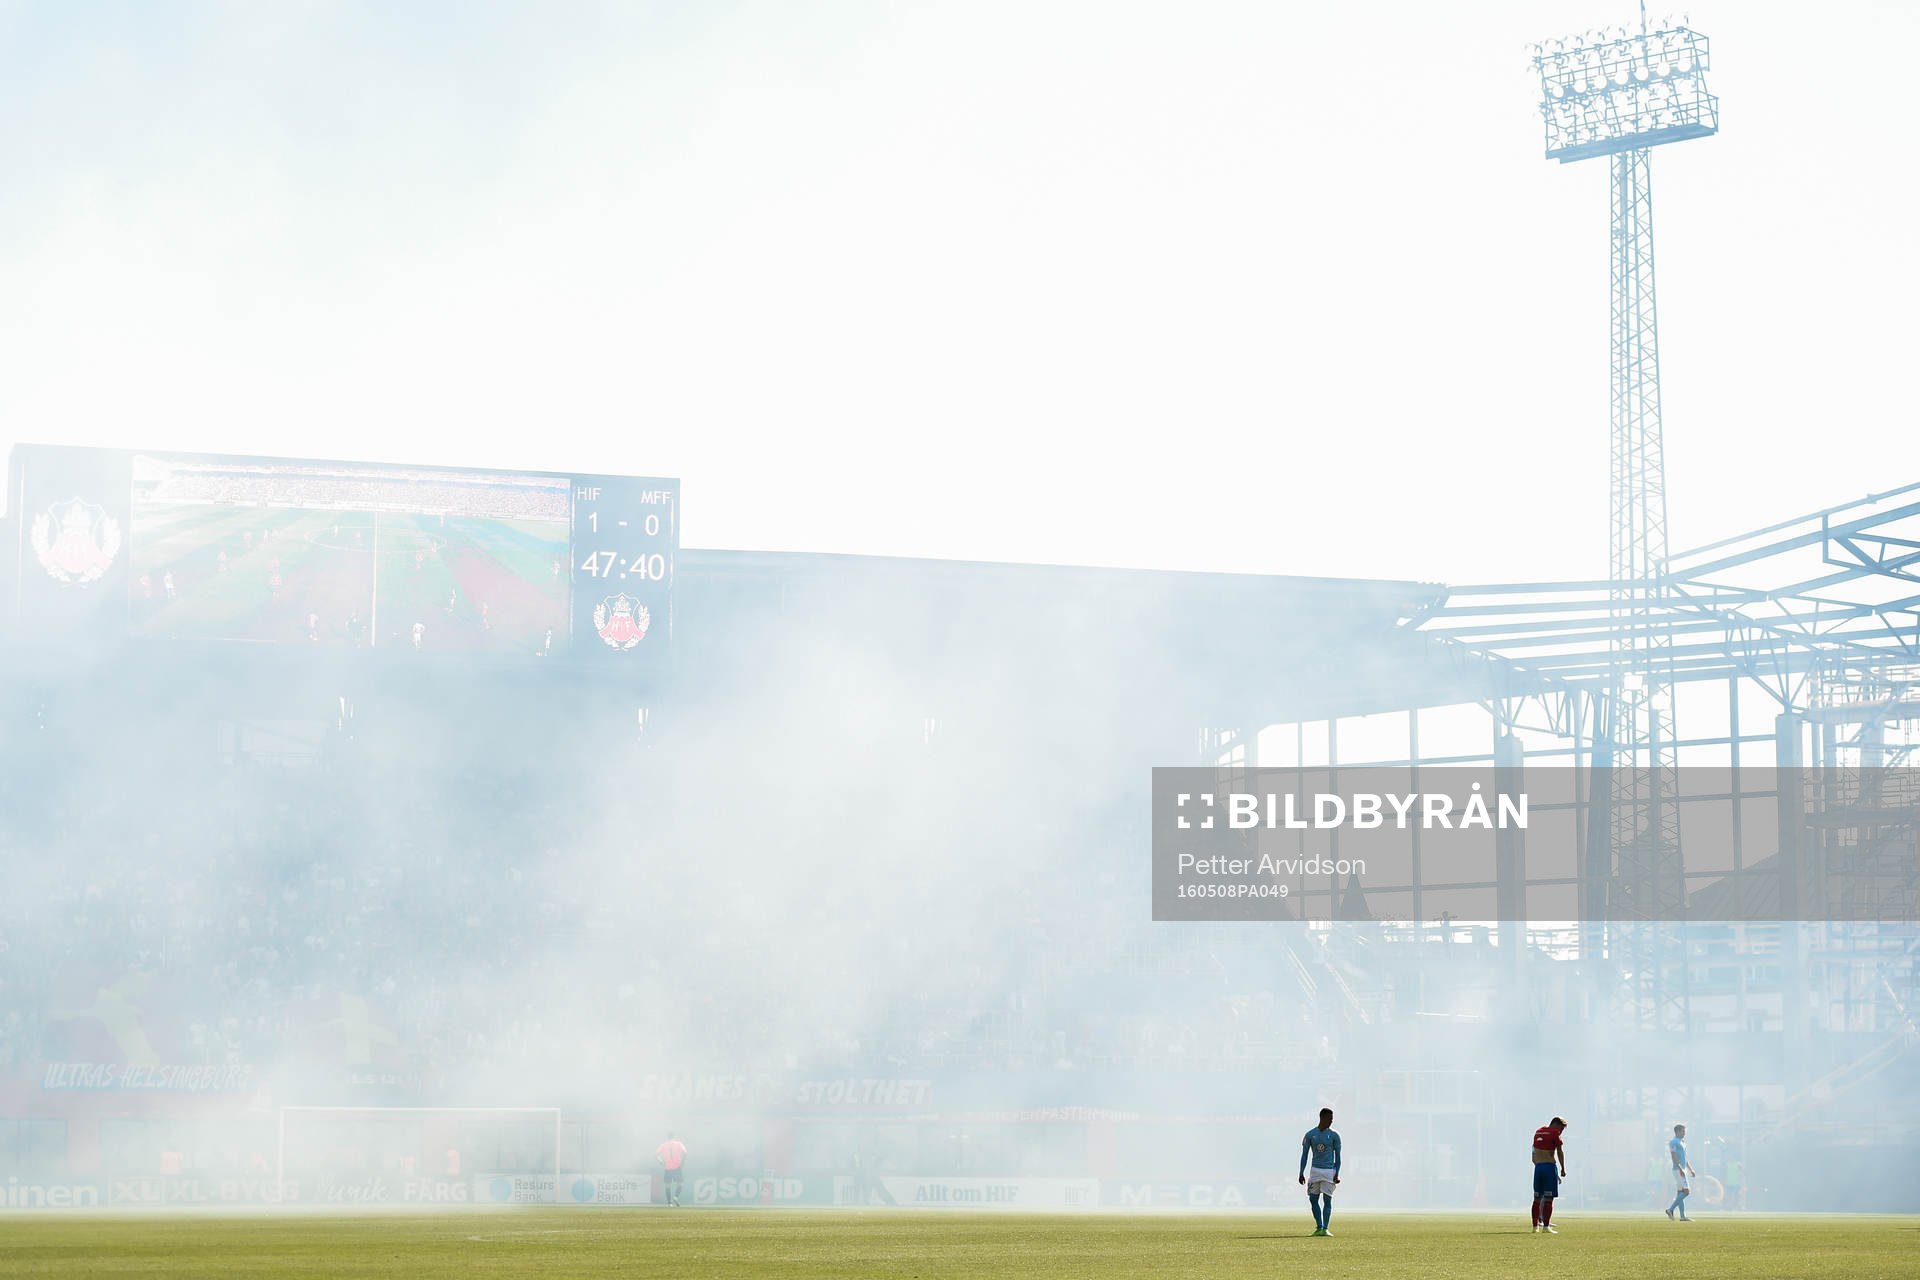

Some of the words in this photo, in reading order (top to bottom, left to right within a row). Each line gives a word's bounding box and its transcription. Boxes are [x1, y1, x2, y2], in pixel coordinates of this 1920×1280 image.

[577, 487, 602, 500] HIF
[641, 491, 672, 505] MFF
[589, 511, 598, 533] 1
[645, 514, 659, 536] 0
[581, 551, 665, 581] 47:40
[44, 1062, 115, 1089] ULTRAS
[797, 1079, 932, 1105] STOLTHET
[514, 1177, 555, 1191] Resurs
[514, 1190, 543, 1201] Bank
[597, 1191, 625, 1202] Bank
[915, 1185, 948, 1202] Allt
[952, 1190, 982, 1202] om
[985, 1185, 1019, 1202] HIF
